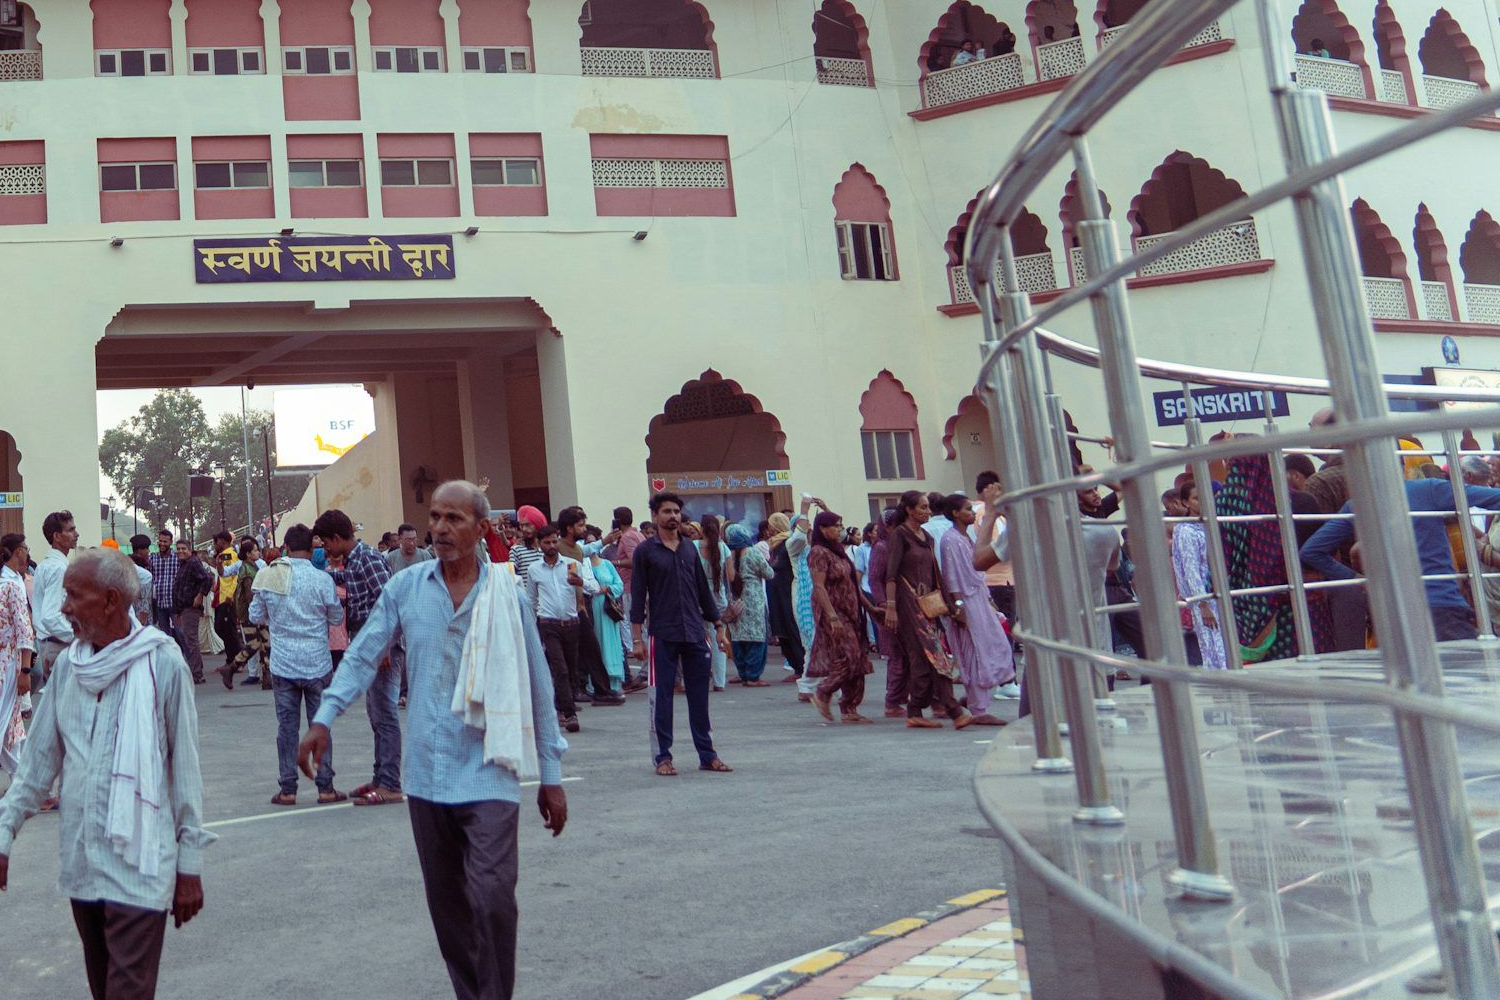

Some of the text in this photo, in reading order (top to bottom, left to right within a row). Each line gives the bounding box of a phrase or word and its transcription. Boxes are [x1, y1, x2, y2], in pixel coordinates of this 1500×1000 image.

[198, 237, 451, 278] स्वर्ण जयन्ती द्वार
[1161, 390, 1276, 419] SANSKRITI
[329, 420, 355, 430] BSF
[777, 472, 789, 480] LIC
[8, 494, 21, 503] LIC
